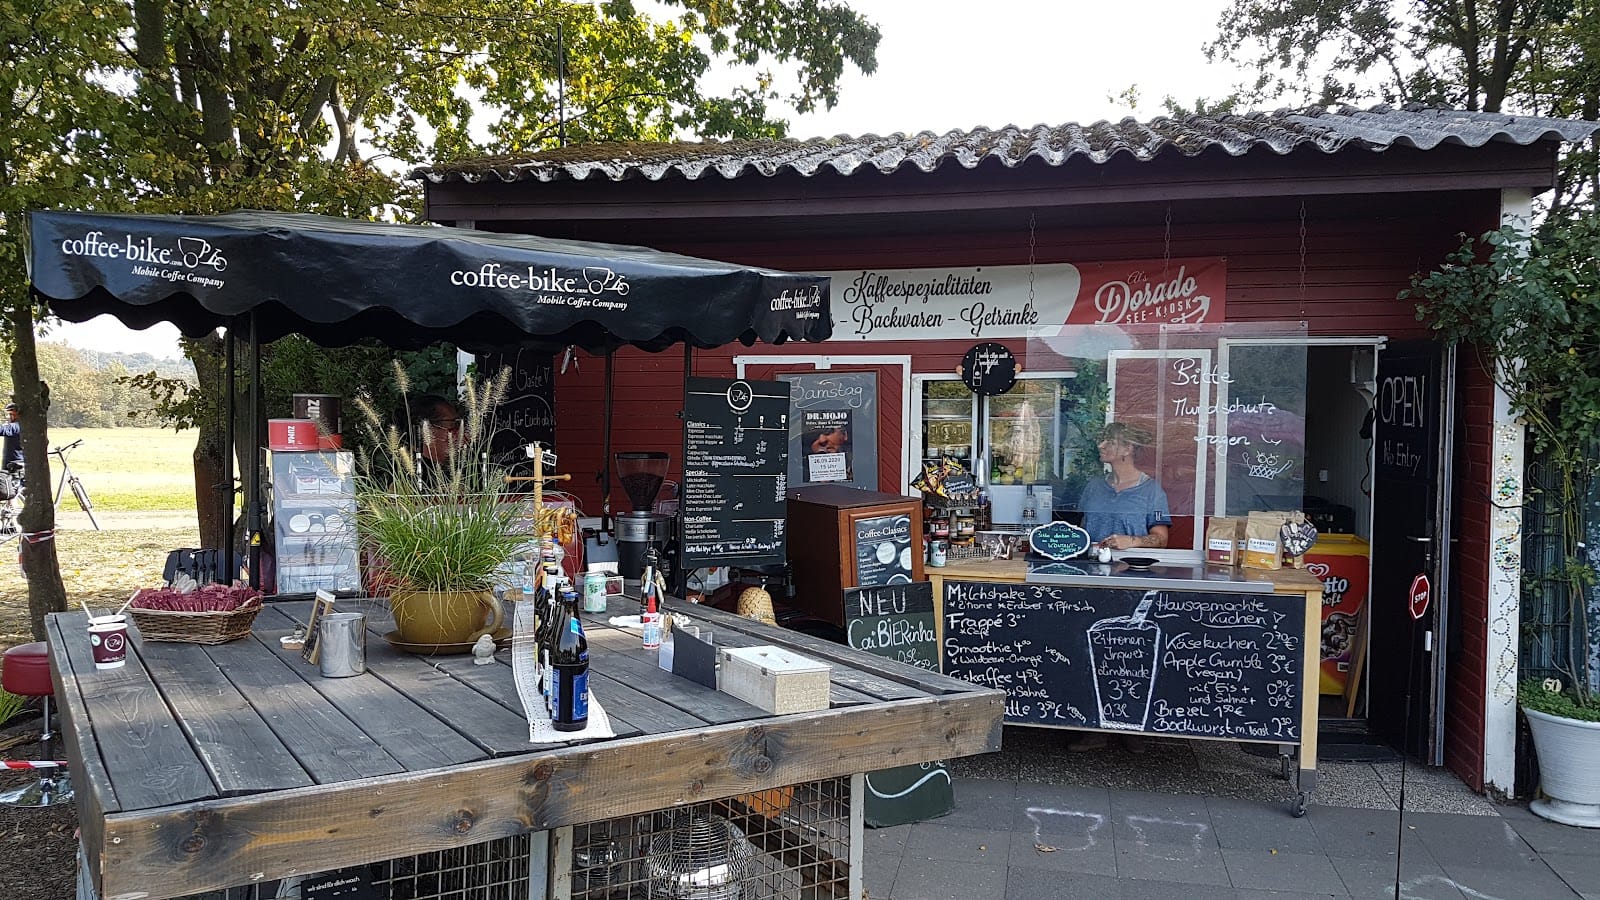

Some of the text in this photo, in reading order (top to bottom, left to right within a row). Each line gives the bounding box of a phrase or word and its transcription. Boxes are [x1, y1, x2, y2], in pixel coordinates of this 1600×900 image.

[62, 231, 171, 264] coffee-bike
[132, 266, 225, 289] Mobile Coffee Company
[451, 263, 575, 293] coffee-bike
[843, 271, 993, 307] Kaffeespezialitäten
[1094, 265, 1198, 326] Dorado
[537, 295, 628, 311] Mobile Coffee Company
[770, 289, 808, 311] coffee-bike
[852, 304, 944, 335] Backwaren
[960, 302, 1039, 337] Getränke
[1170, 358, 1235, 386] Bitte
[1171, 394, 1277, 418] Mundschutz
[1380, 374, 1426, 428] OPEN
[806, 412, 847, 421] DR.MOJO
[287, 425, 296, 444] ZUMA
[1383, 439, 1422, 477] No Entry
[857, 526, 908, 540] Coffee-Classics
[859, 589, 906, 617] NEU
[947, 584, 1027, 601] Milchshake
[1414, 591, 1427, 604] STOP
[1155, 592, 1269, 622] Hausgemachte
[946, 612, 1003, 630] Frappé
[1209, 610, 1268, 626] Kuchen
[945, 637, 1012, 657] Smoothie
[1165, 631, 1260, 651] Käsekuchen
[1163, 650, 1207, 673] Apple
[949, 666, 1013, 687] Eiskaffee
[1186, 666, 1243, 685] (vegan)
[1188, 682, 1211, 693] mit
[1215, 682, 1238, 693] Eis
[1004, 699, 1031, 717] atte
[1153, 698, 1210, 718] Brezel
